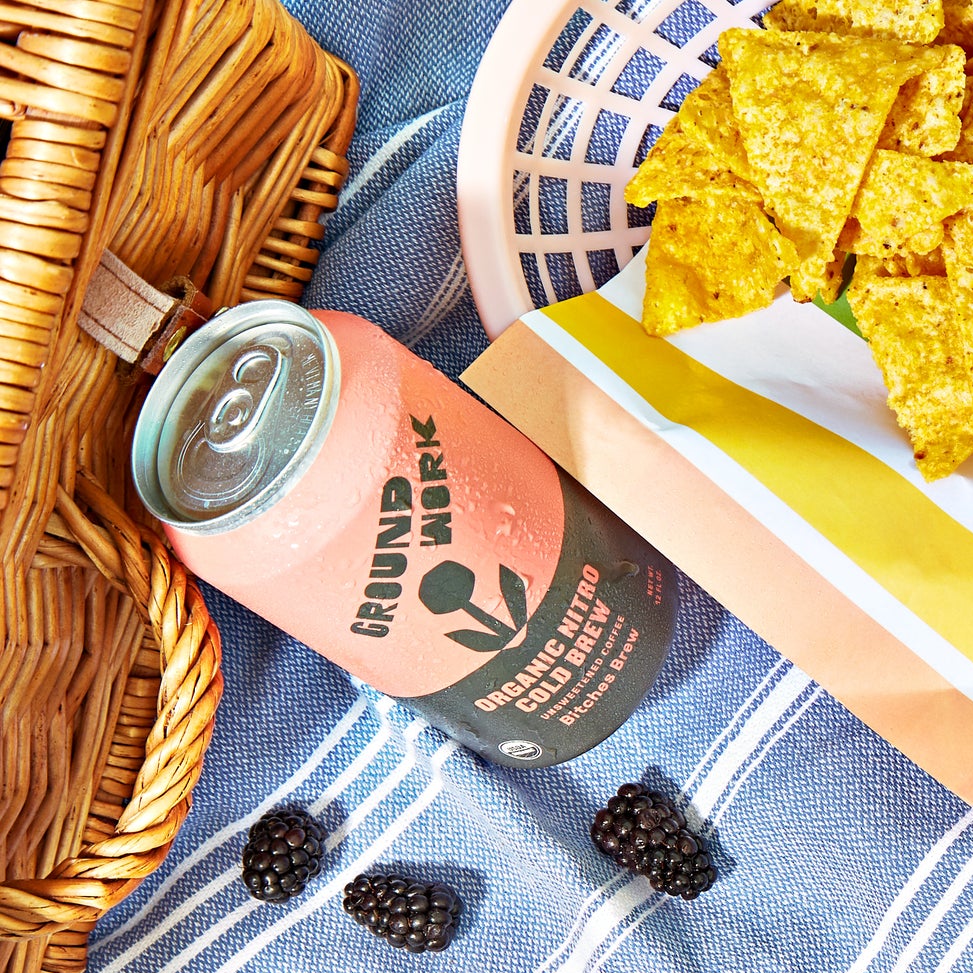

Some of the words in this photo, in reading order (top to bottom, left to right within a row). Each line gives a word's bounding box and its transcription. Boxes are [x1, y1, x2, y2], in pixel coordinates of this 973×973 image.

[409, 413, 452, 547] WORK
[350, 476, 412, 638] GROUND
[474, 638, 566, 712] ORGANIC
[556, 563, 599, 639] NITRO
[514, 666, 572, 713] COLD
[564, 598, 611, 668] BREW
[540, 658, 604, 720] UNSWEETENED
[601, 614, 625, 656] COFFEE
[559, 673, 616, 727] Bitches
[609, 627, 640, 672] Brew
